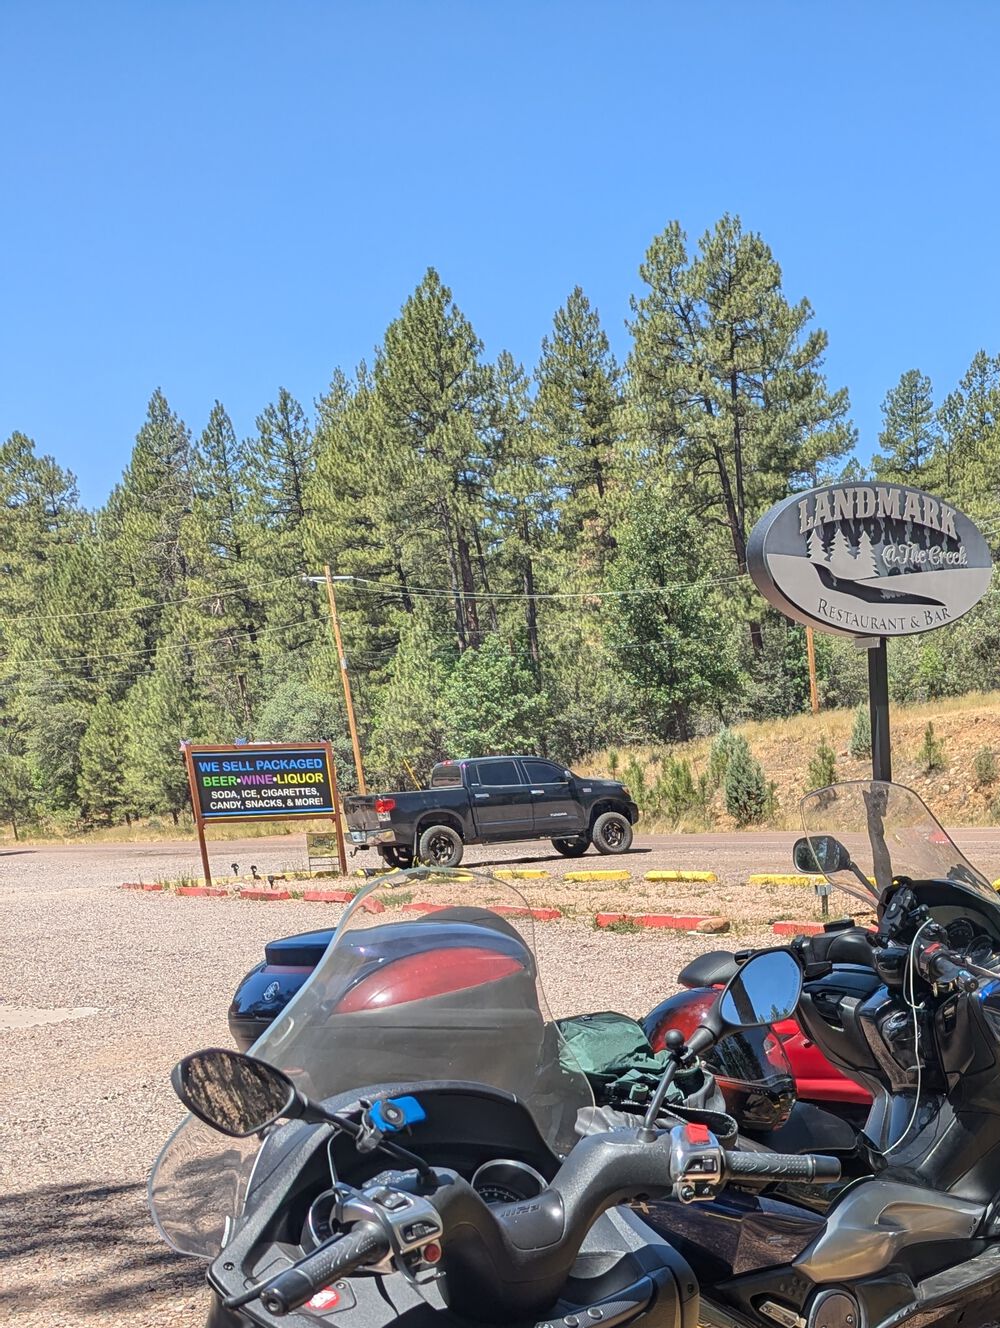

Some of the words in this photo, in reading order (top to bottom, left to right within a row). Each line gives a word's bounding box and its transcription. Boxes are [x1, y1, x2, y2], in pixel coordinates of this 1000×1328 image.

[799, 487, 958, 541] LANDMARK
[910, 619, 919, 629] &
[199, 762, 219, 772] WE
[223, 761, 254, 771] SELL
[256, 759, 322, 770] PACKAGED
[212, 790, 240, 799] SODA,
[242, 790, 260, 798] ICE,
[262, 788, 319, 797] CIGARETTES,
[210, 801, 244, 810] CANDY,
[245, 799, 285, 808] SNACKS,
[294, 798, 323, 806] MORE!
